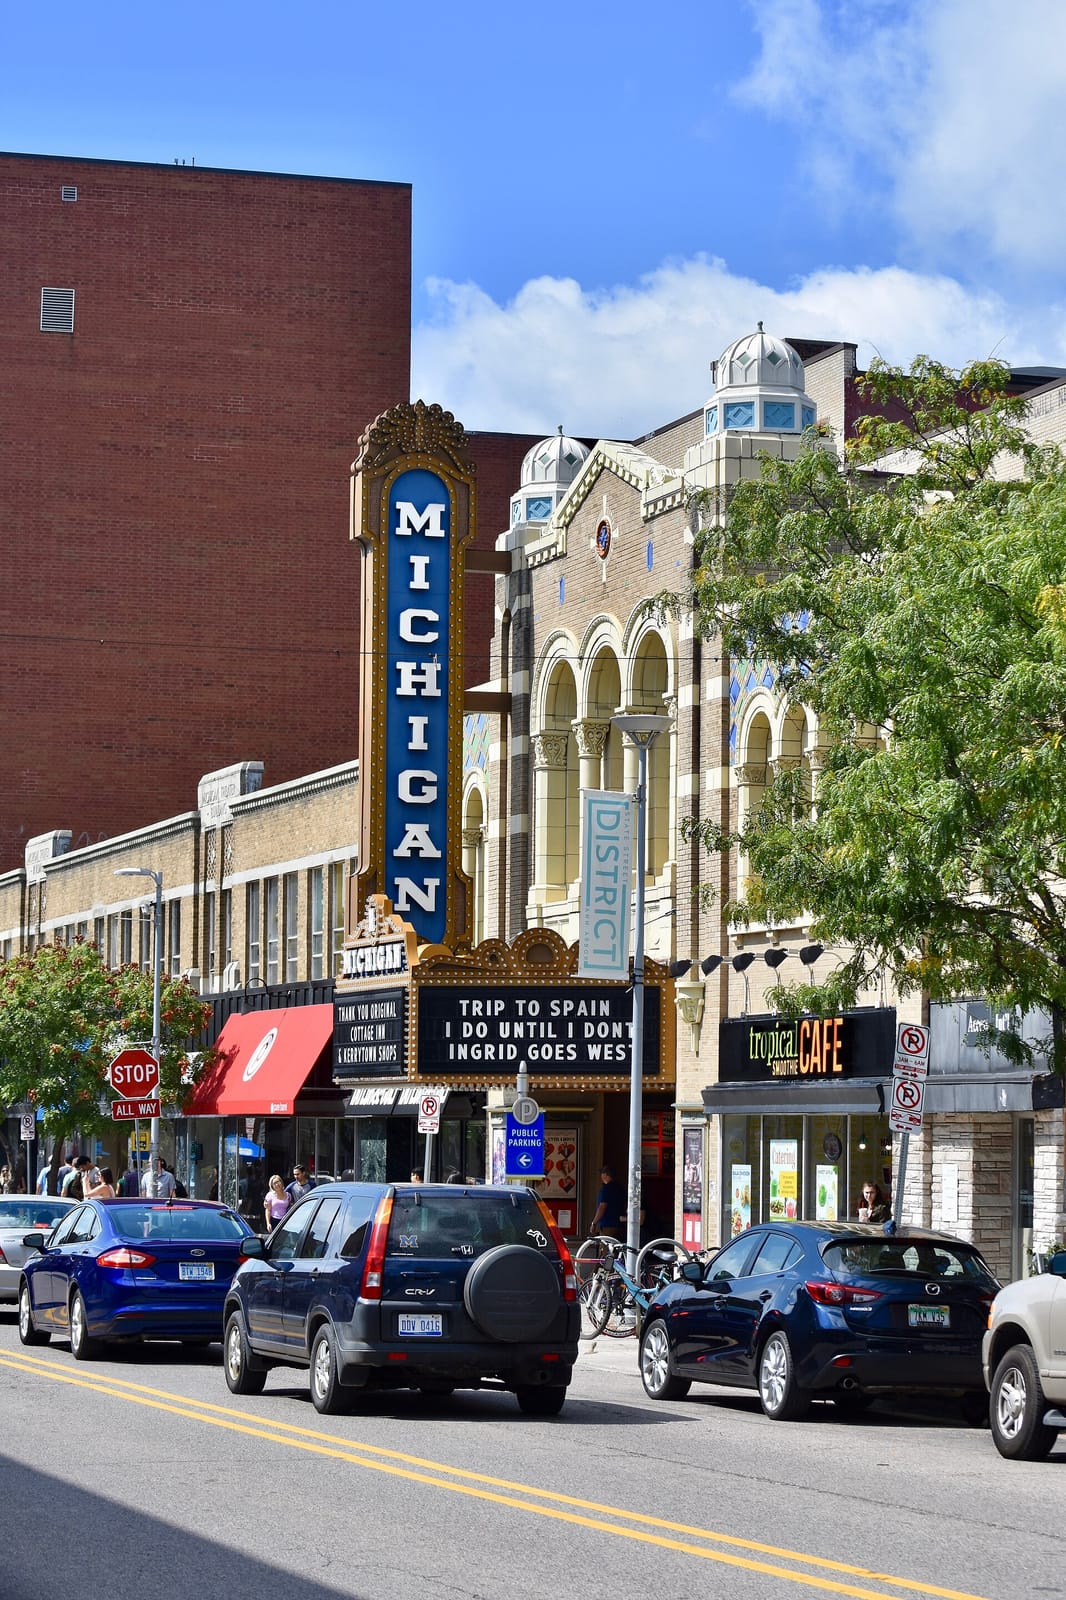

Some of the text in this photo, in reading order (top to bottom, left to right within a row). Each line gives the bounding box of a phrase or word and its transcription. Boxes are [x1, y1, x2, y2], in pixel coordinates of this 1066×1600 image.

[393, 501, 446, 913] MICHIGAN
[622, 809, 631, 883] STATE STREET
[593, 809, 621, 962] DISTRICT
[342, 943, 402, 975] MICHIGAN
[338, 1001, 397, 1022] THANK YOU ORIGINAL
[459, 1000, 610, 1017] TRIP TO SPAIN
[350, 1023, 386, 1042] COTTAGE INN
[445, 1022, 633, 1039] I DO UNTIL I DONT
[338, 1044, 397, 1064] & KERRYTOWN SHOPS
[449, 1043, 518, 1060] INGRID
[527, 1043, 577, 1061] GOES
[749, 1018, 844, 1073] tropical CAFE
[113, 1065, 156, 1083] STOP
[772, 1059, 798, 1076] SMOOTHIE
[116, 1103, 157, 1116] ALL WAY
[521, 1101, 533, 1122] P
[511, 1128, 539, 1137] PUBLIC
[508, 1138, 542, 1147] PARKING
[401, 1319, 416, 1331] DDV
